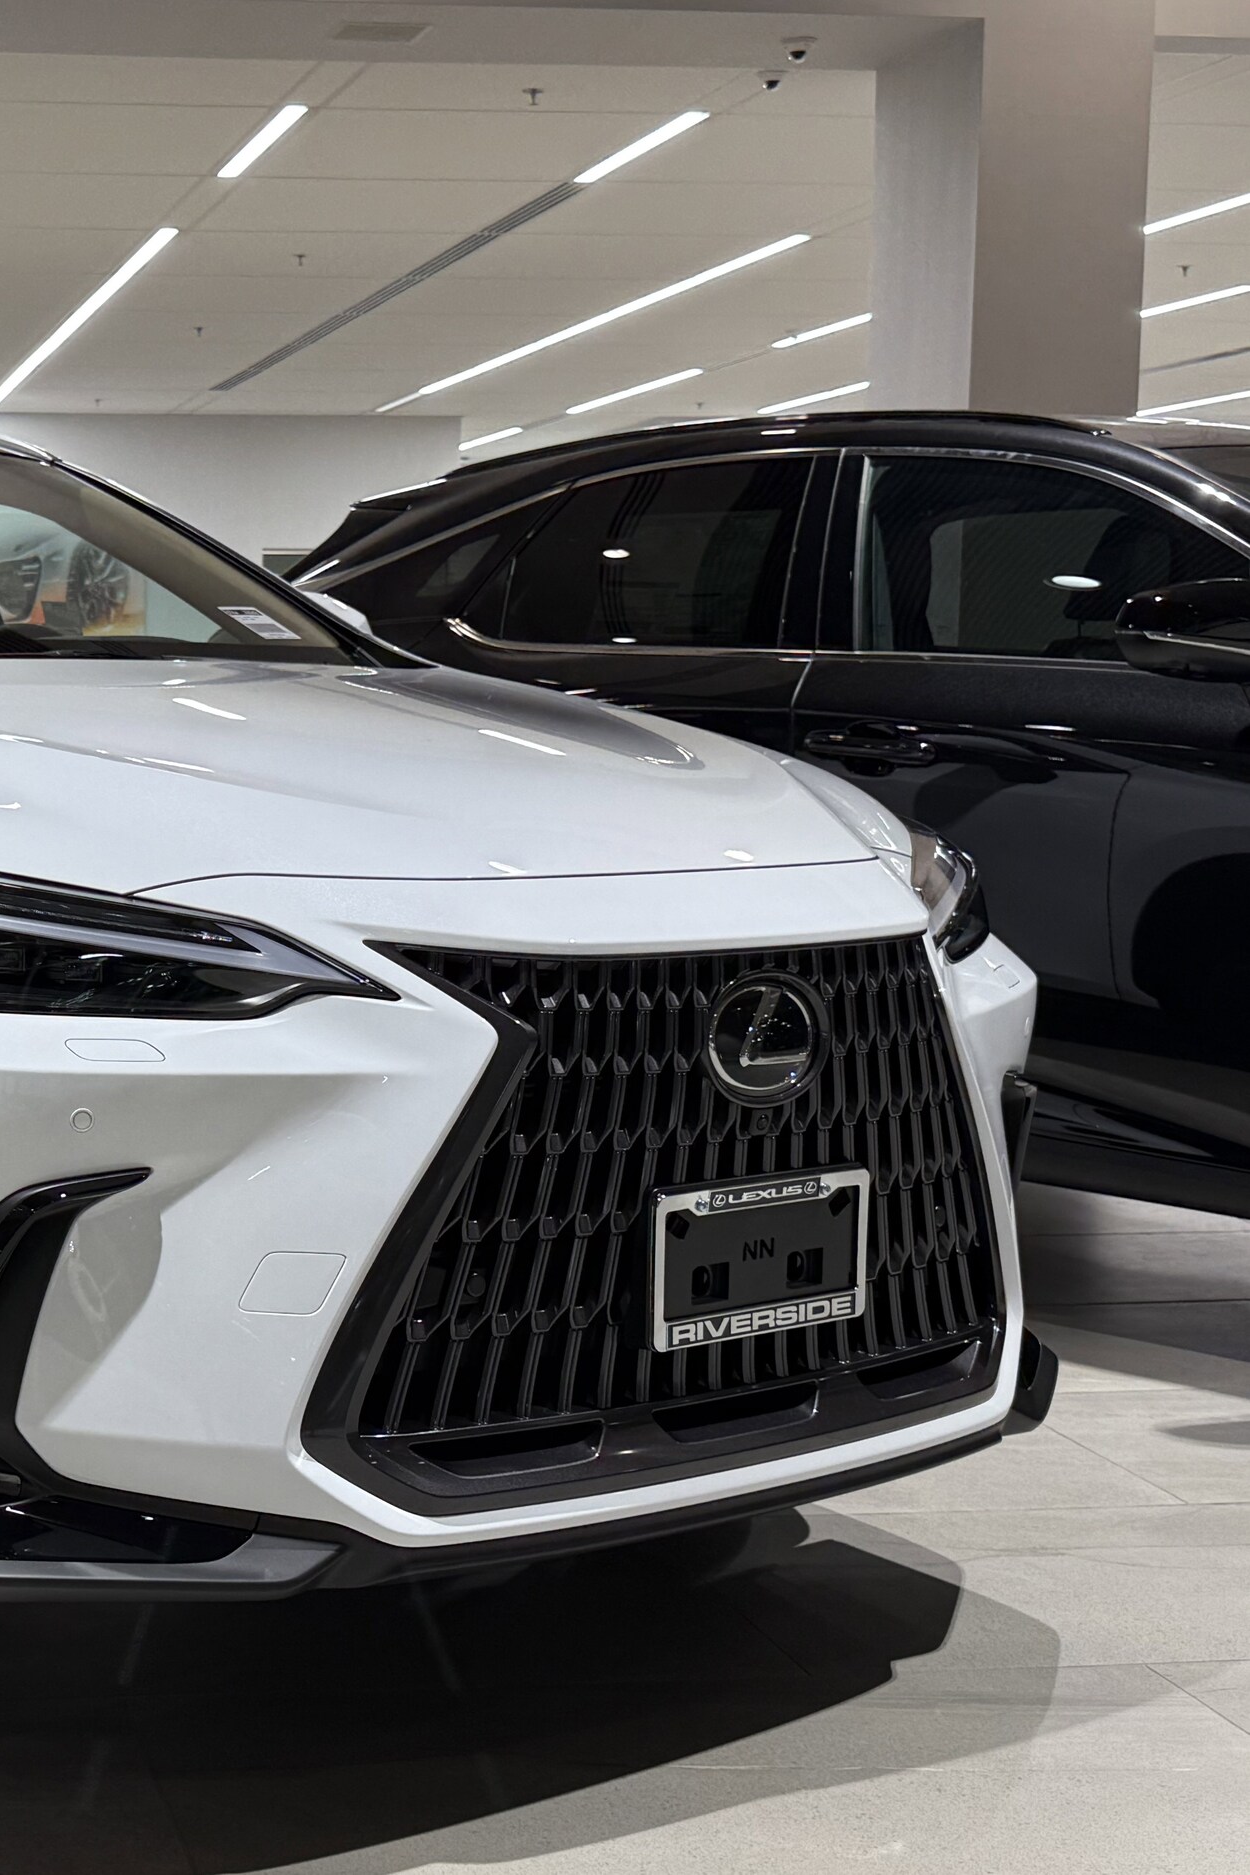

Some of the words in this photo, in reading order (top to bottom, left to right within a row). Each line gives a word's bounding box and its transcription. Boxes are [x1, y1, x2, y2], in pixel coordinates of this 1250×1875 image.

[728, 1184, 803, 1204] LEXUS
[742, 1237, 776, 1262] NN
[672, 1296, 852, 1346] RIVERSIDE
